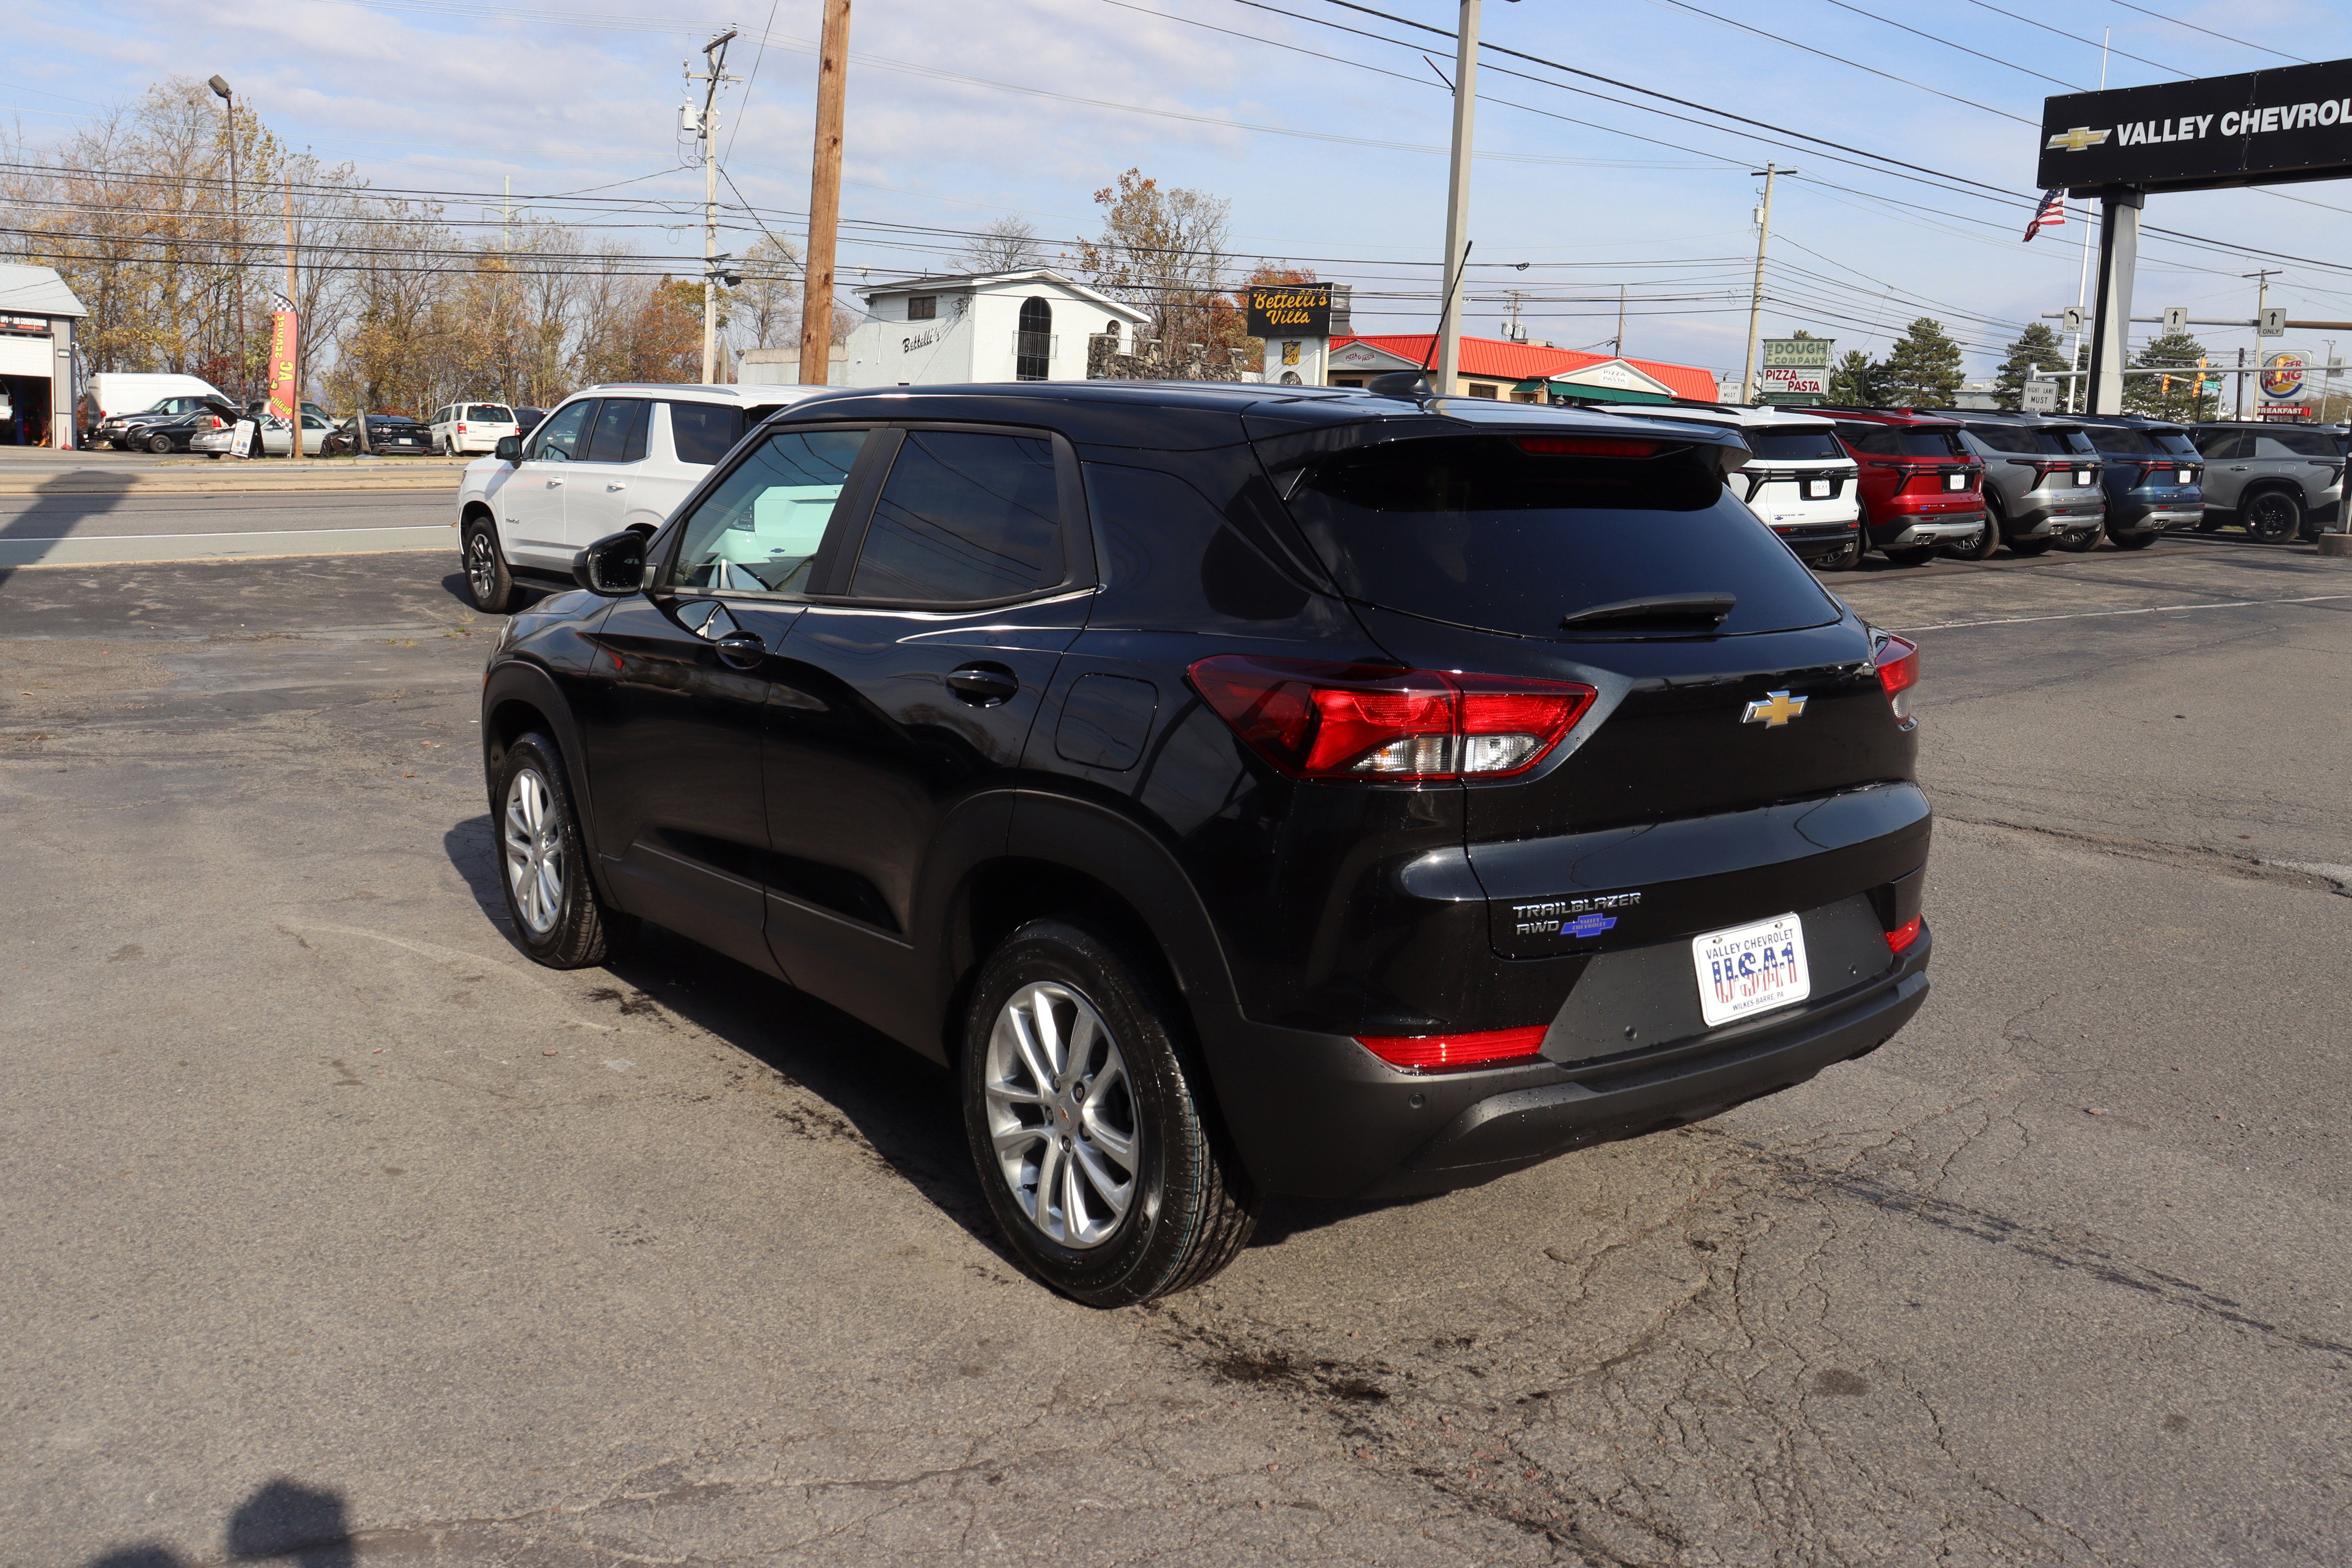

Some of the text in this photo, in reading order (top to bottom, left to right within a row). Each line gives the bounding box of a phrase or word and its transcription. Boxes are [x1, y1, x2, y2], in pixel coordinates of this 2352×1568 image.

[2117, 114, 2214, 146] VALLEY
[1253, 286, 1328, 310] Bettelli's
[20, 318, 47, 327] CONDITIONING
[1266, 308, 1311, 325] Villa
[902, 327, 940, 354] Bettelli's
[1775, 343, 1826, 355] DOUGH
[1362, 354, 1375, 362] PASTA
[1774, 356, 1826, 365] COMPANY
[1766, 370, 1797, 381] PIZZA
[1788, 381, 1820, 392] PASTA
[2030, 396, 2048, 404] MUST
[1512, 892, 1642, 918] TRAILBLAZER
[1516, 920, 1559, 935] AWD
[1572, 921, 1606, 931] CHEVROLET
[1706, 928, 1794, 960] VALLEY CHEVROLET
[1733, 994, 1776, 1011] WILKES-BARRE,
